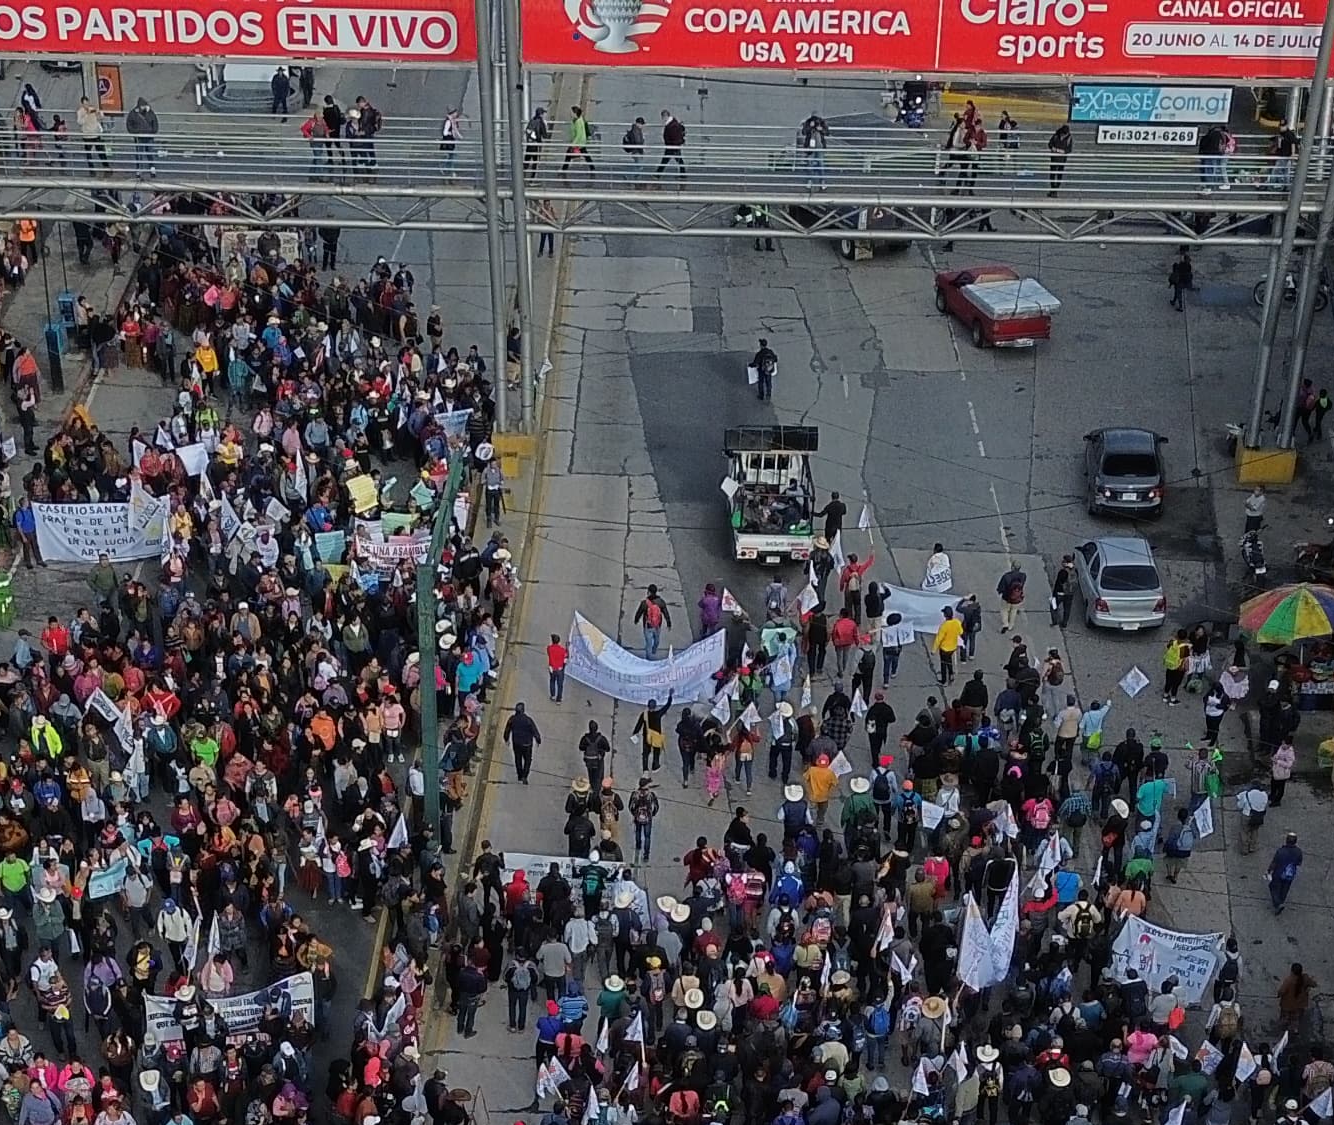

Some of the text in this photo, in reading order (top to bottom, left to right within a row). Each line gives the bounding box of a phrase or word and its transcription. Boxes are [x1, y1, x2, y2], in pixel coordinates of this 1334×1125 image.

[1158, 1, 1304, 19] CANAL OFICIAL
[56, 7, 264, 45] PARTIDOS
[285, 13, 339, 46] EN
[348, 15, 452, 50] VIVO
[684, 8, 911, 36] COPA AMERICA
[998, 31, 1105, 64] sports
[1132, 33, 1152, 47] 20
[1155, 33, 1206, 48] JUNIO
[1210, 34, 1229, 48] AL
[1233, 34, 1249, 48] 14
[1253, 35, 1275, 48] DE
[740, 41, 853, 64] USA 2024
[1089, 110, 1140, 121] Publicidad
[1101, 129, 1195, 142] Tel:3021-6269
[38, 504, 88, 515] CASERIO
[105, 535, 137, 546] LUCHA
